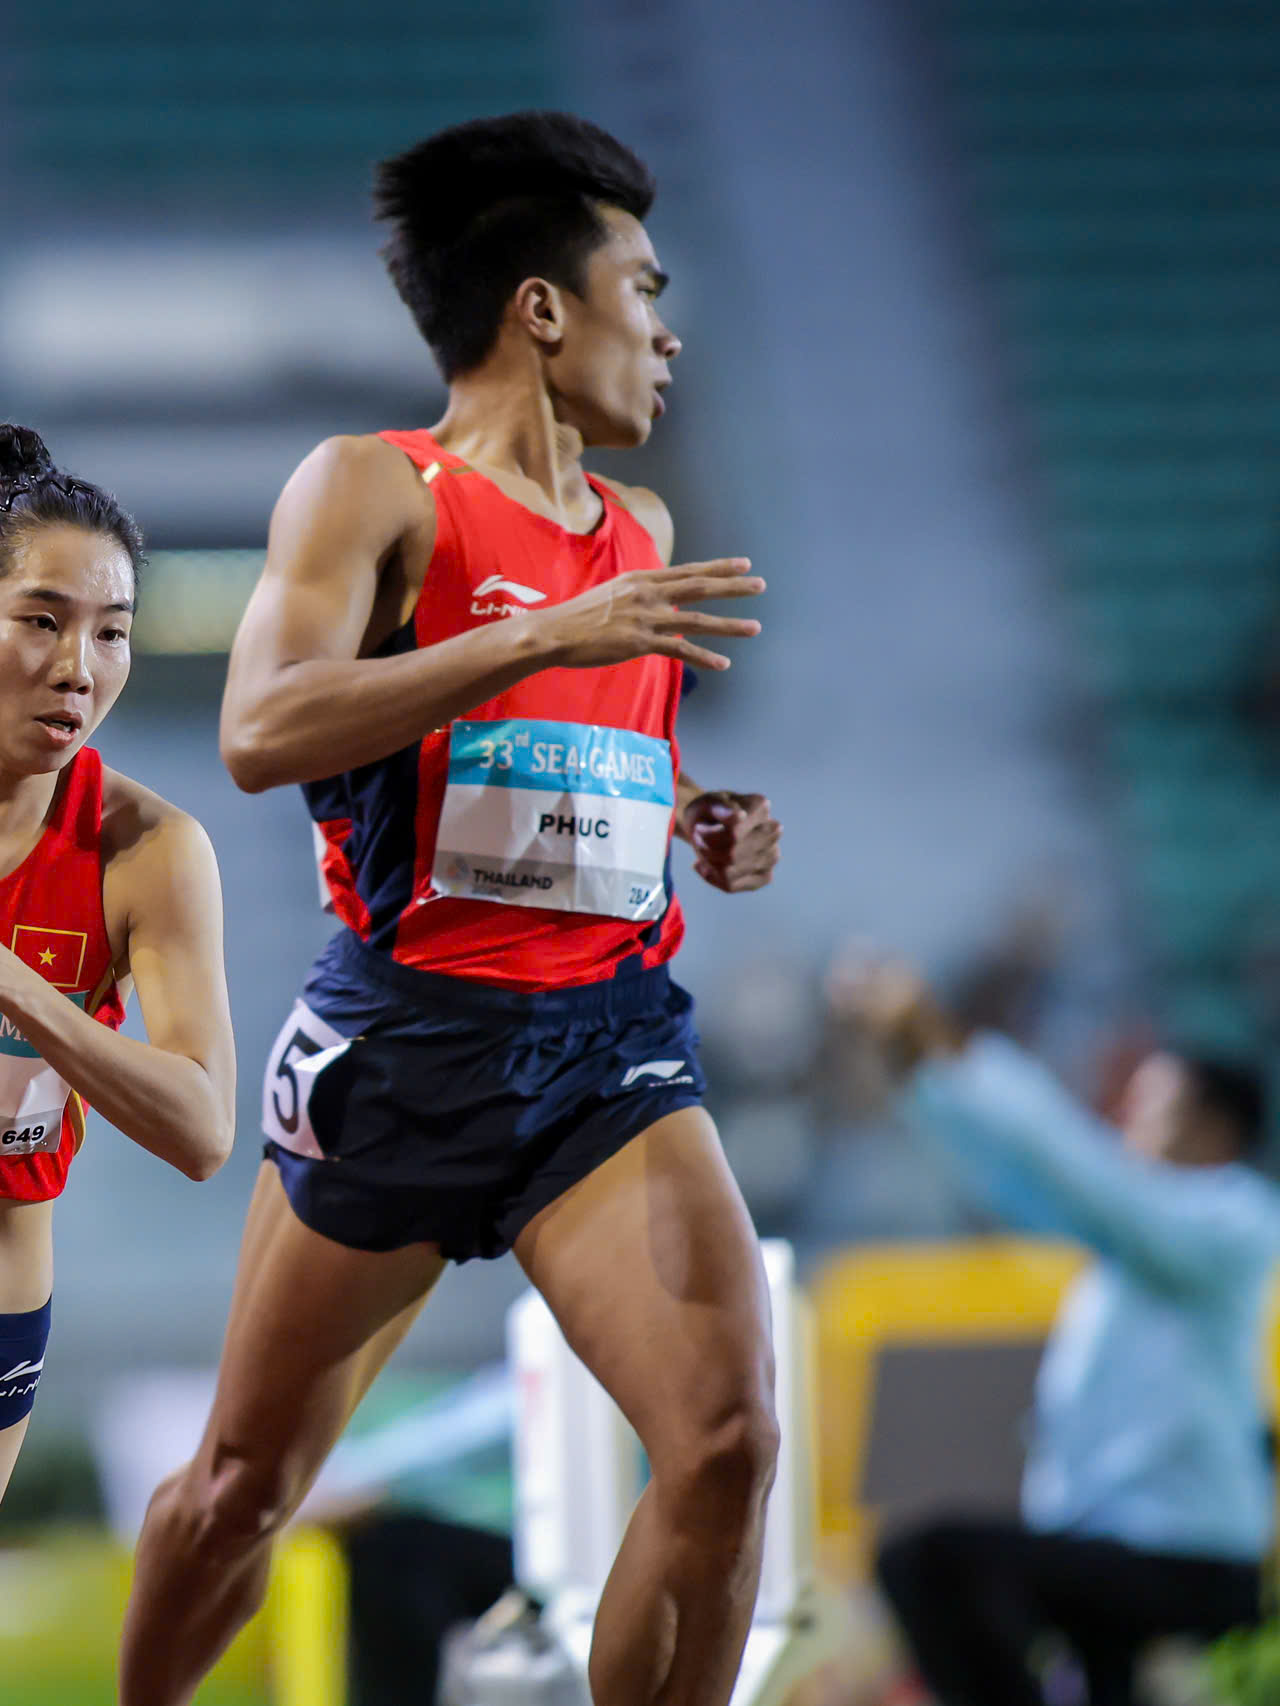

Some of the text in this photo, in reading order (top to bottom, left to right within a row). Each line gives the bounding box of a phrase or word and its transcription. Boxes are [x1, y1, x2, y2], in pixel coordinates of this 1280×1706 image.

[479, 732, 656, 785] 33rd SEA GAMES
[538, 814, 610, 839] PHUC
[473, 868, 553, 890] THAILAND
[272, 1027, 325, 1134] 5
[1, 1125, 45, 1145] 649
